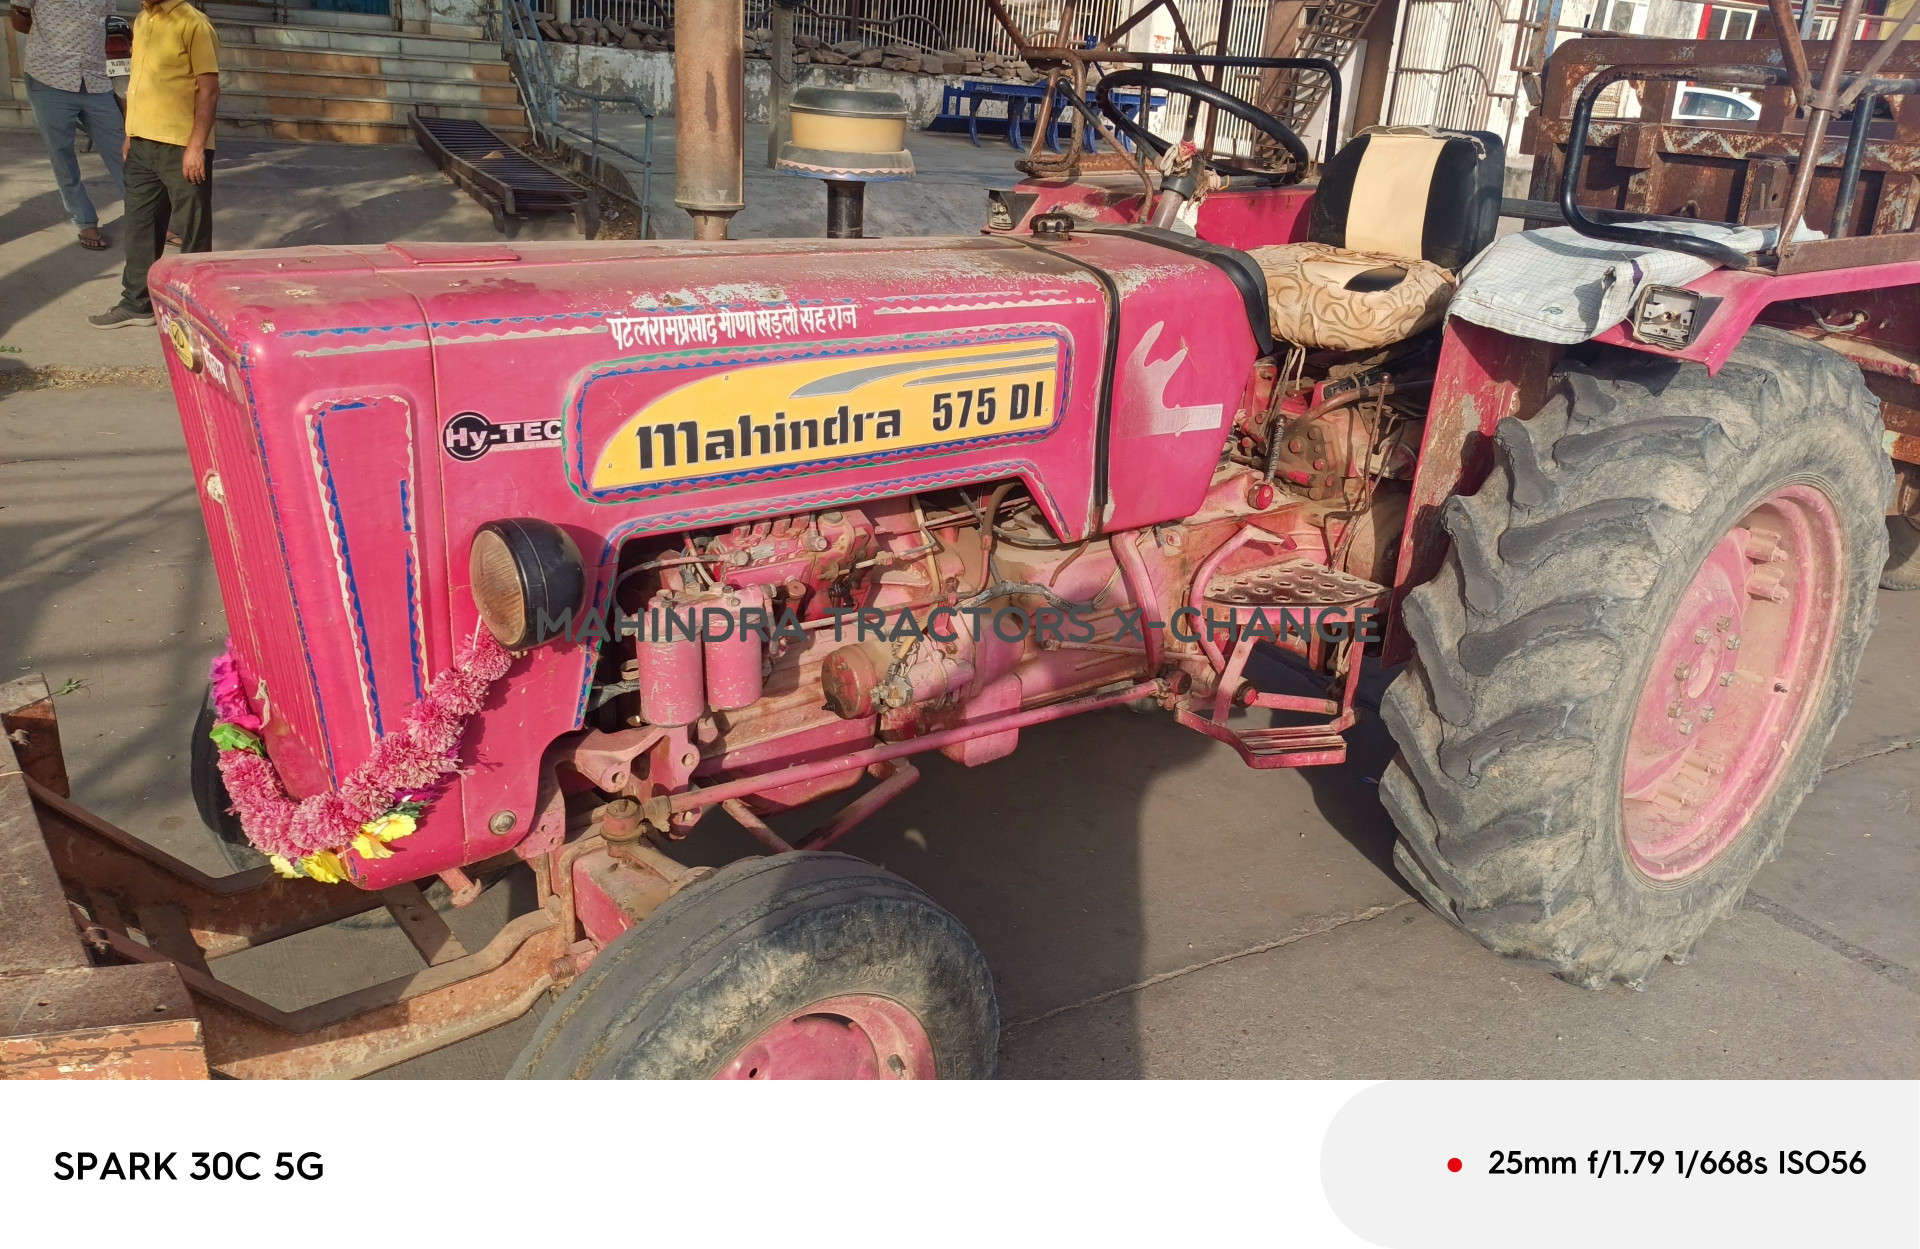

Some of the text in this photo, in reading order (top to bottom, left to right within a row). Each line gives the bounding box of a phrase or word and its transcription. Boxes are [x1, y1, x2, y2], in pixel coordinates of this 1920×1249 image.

[931, 387, 997, 432] 575
[1008, 380, 1044, 421] DI
[445, 420, 562, 451] Hy-TEC
